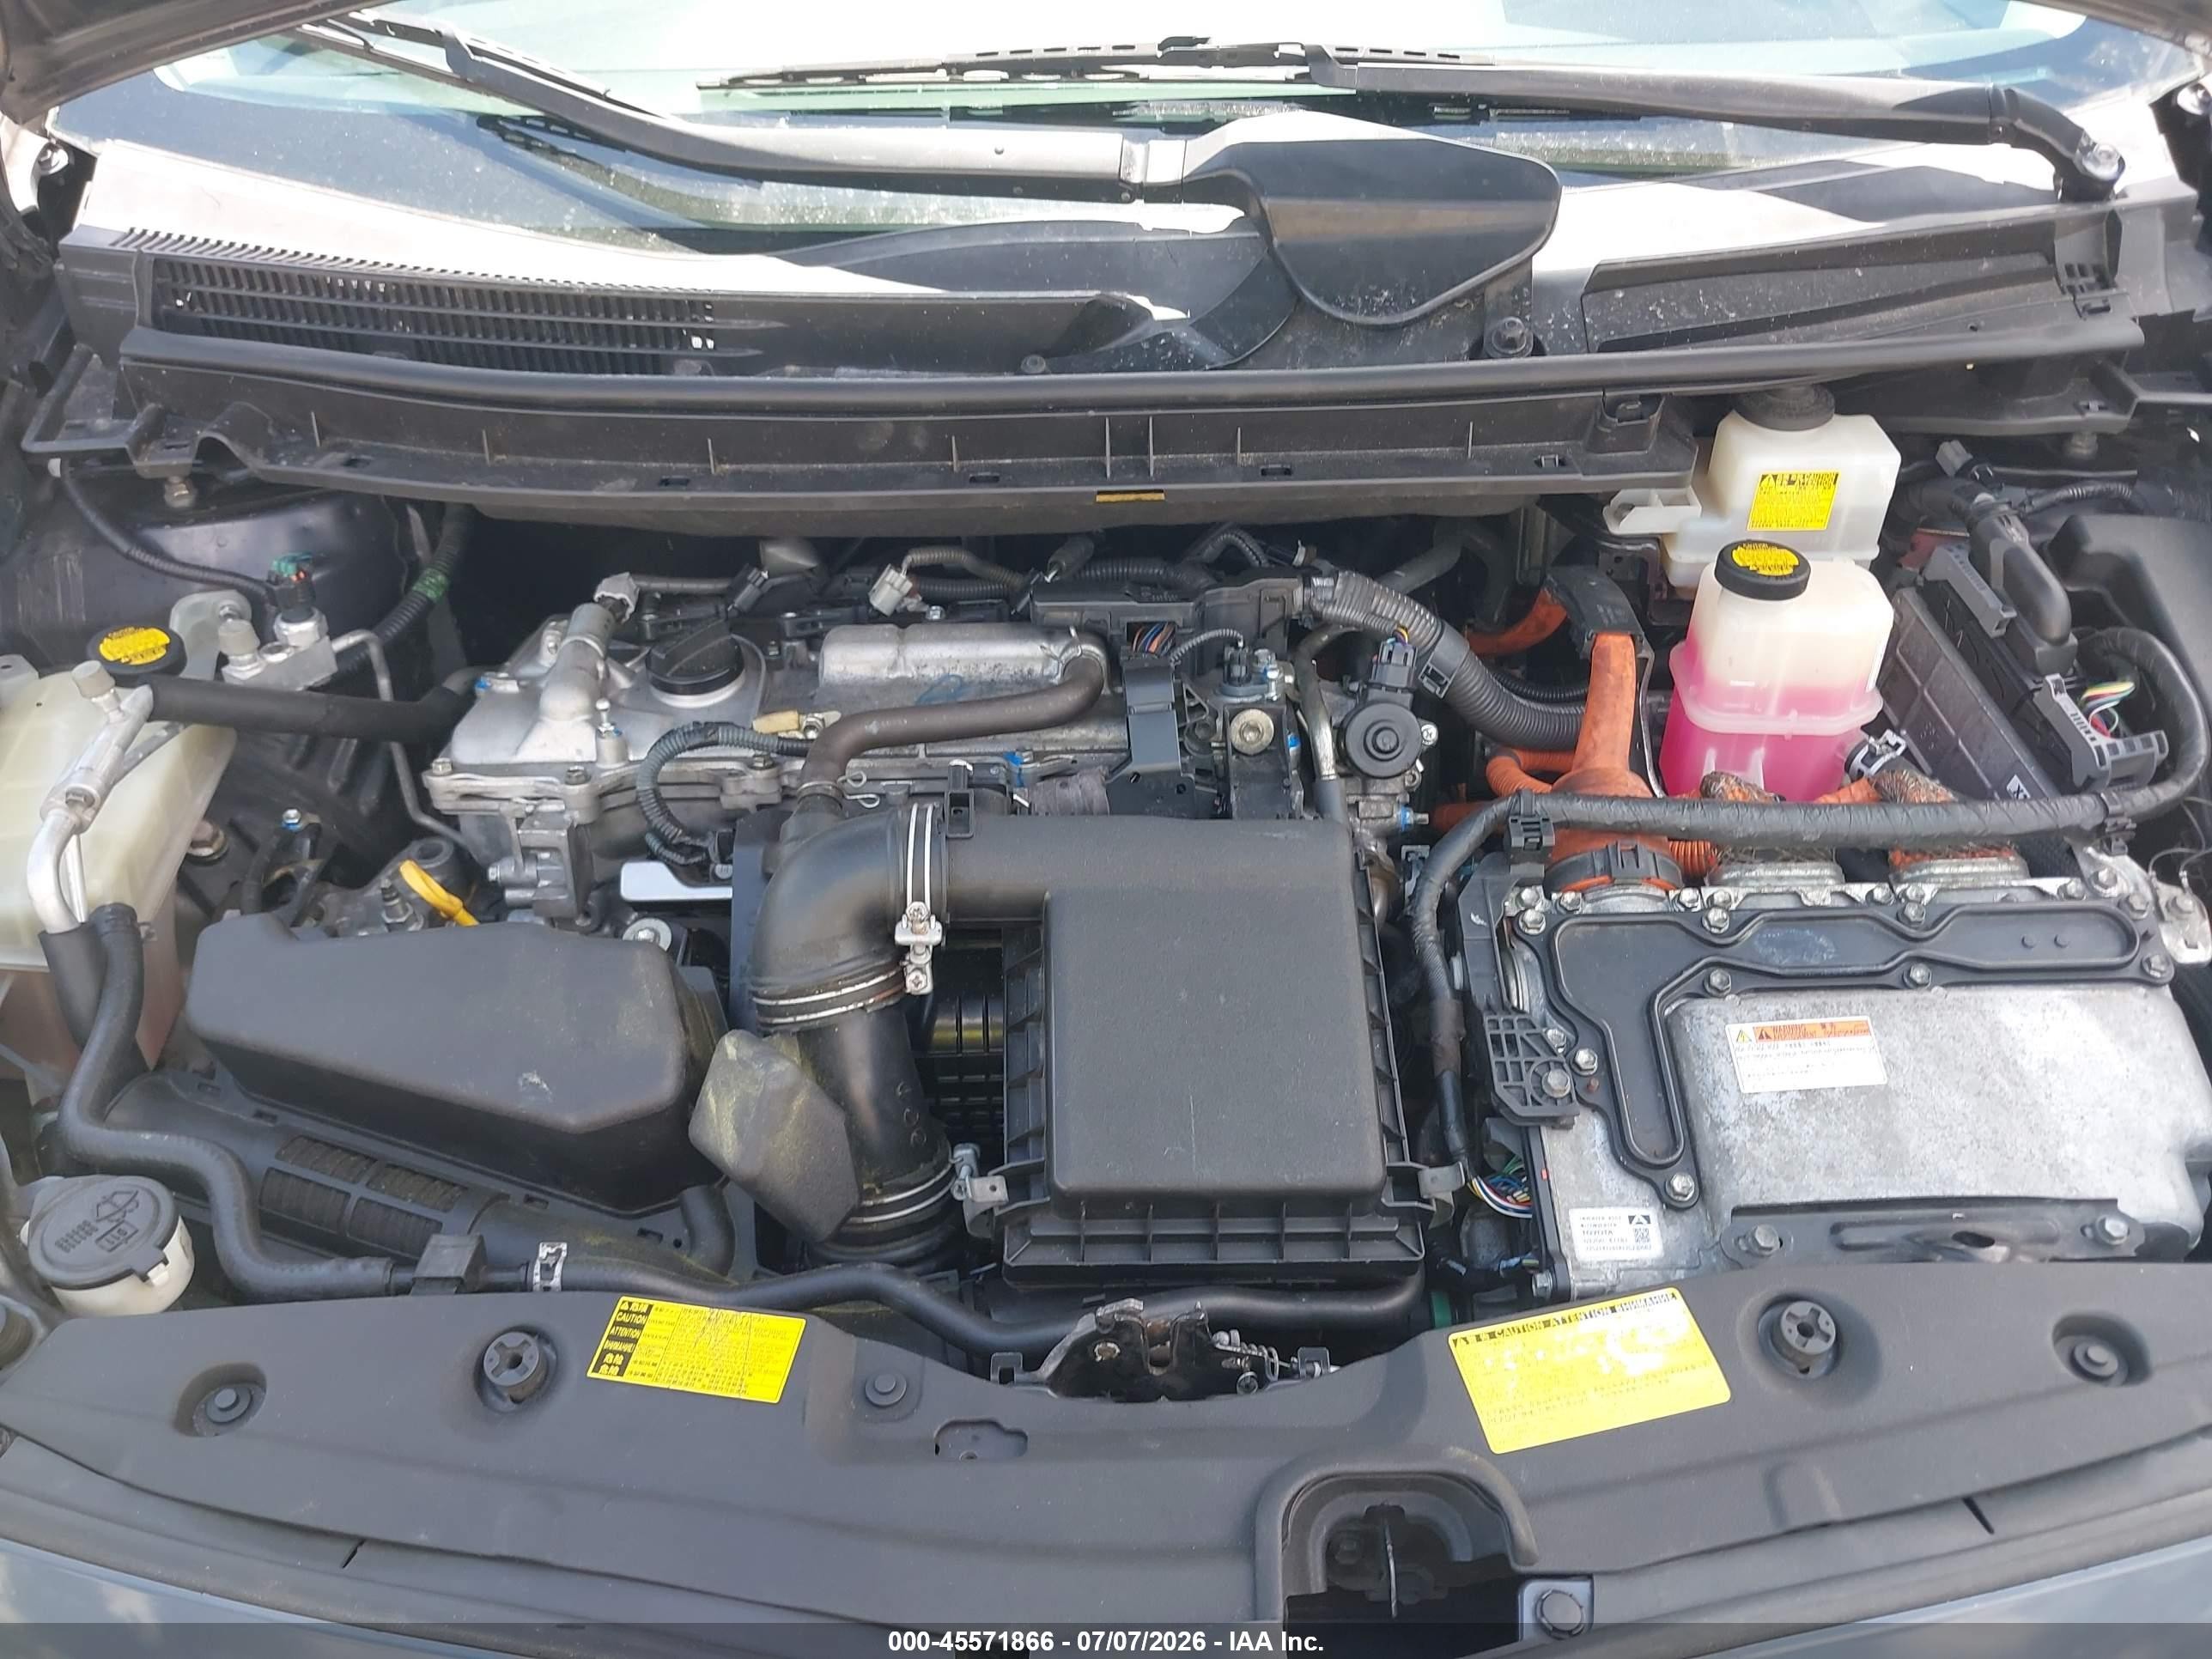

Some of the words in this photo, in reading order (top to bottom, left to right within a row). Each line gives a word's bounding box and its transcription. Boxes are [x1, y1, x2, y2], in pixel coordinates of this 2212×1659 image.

[616, 1311, 647, 1324] CAUTION
[1495, 1320, 1544, 1340] CAUTION
[1551, 1307, 1611, 1328] ATTENTION
[610, 1326, 641, 1338] ATTENTION
